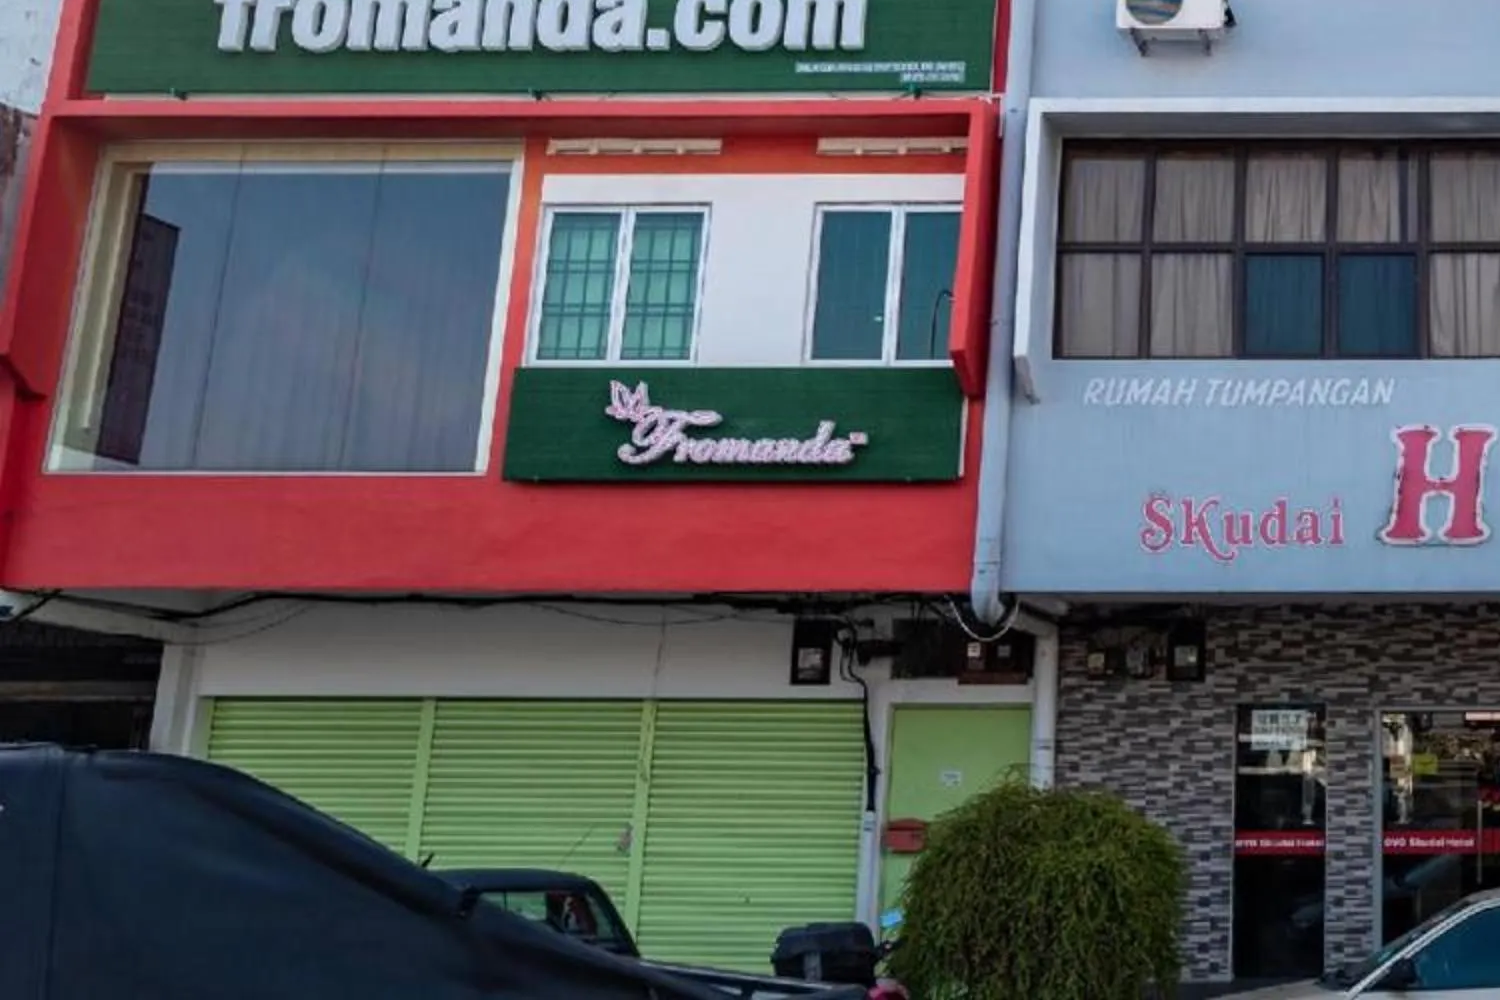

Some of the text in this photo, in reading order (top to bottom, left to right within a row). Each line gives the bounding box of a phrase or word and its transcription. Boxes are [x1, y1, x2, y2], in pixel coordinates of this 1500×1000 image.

[1084, 377, 1396, 407] RUMAH TUMPANGAN
[617, 405, 857, 464] Fromanda
